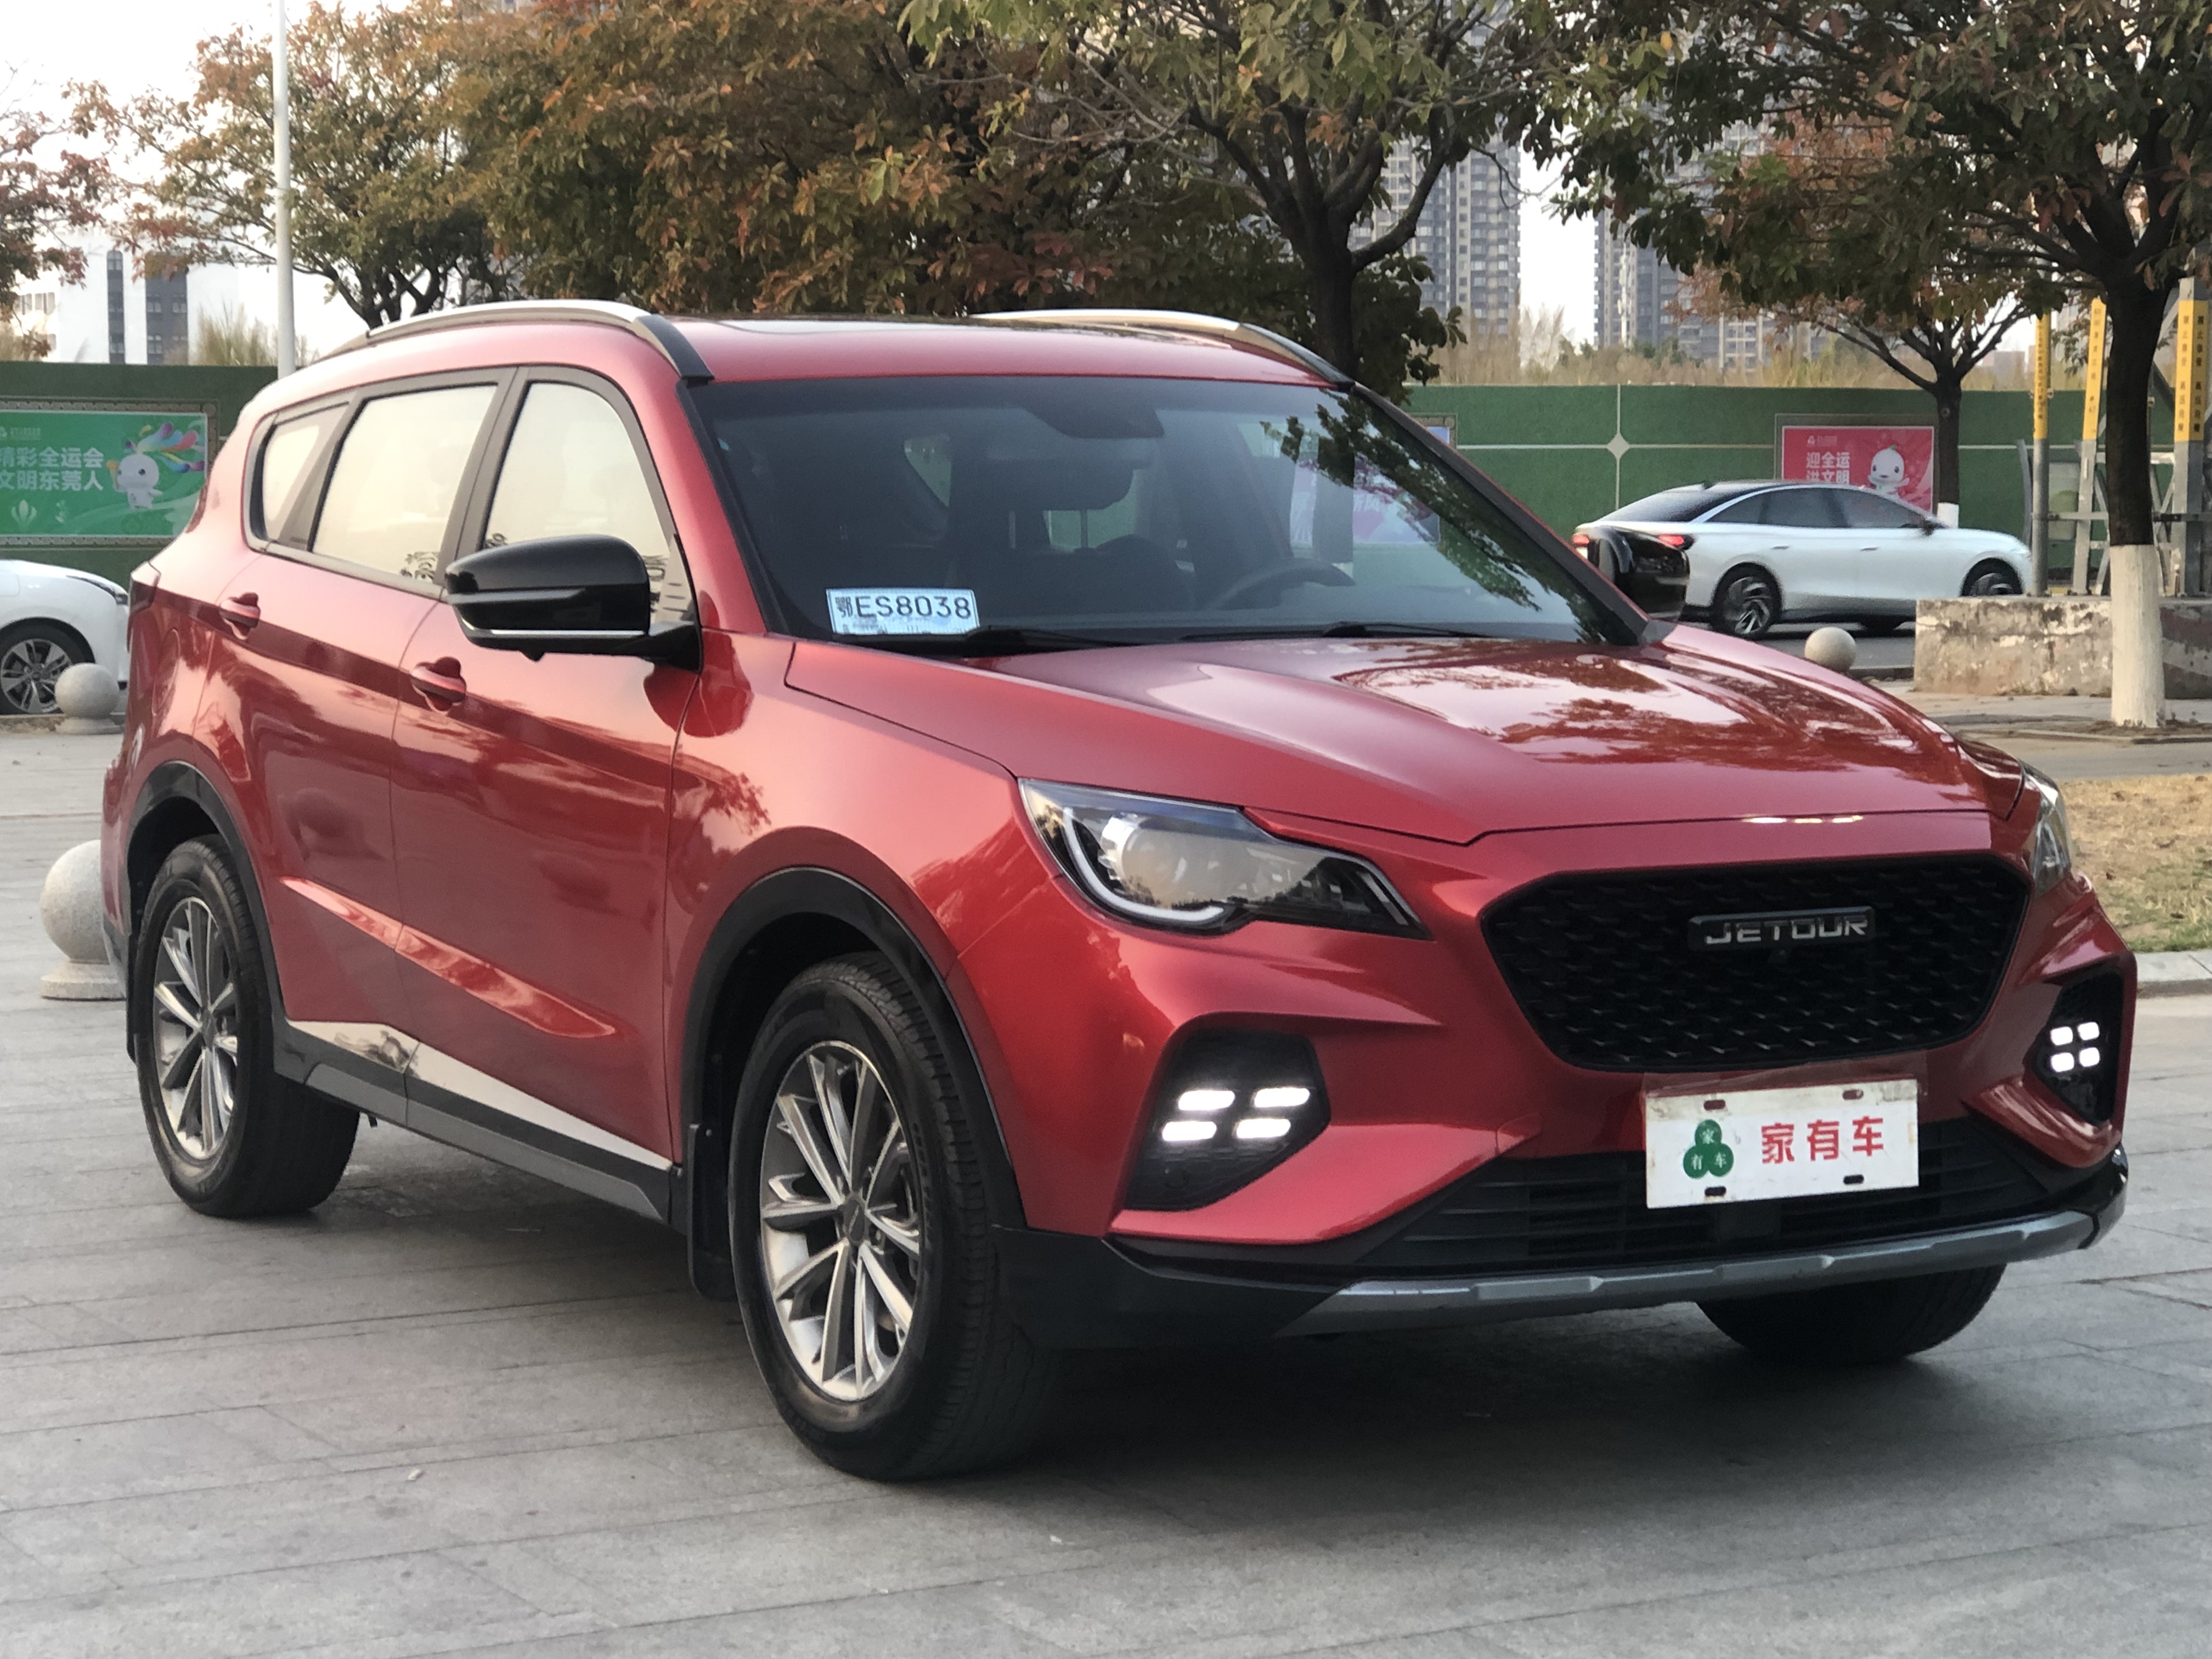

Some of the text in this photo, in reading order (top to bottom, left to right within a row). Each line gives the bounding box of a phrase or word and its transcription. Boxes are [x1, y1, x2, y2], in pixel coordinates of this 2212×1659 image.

[1806, 452, 1850, 469] 迎全运
[0, 470, 104, 491] 文明东莞人
[1705, 916, 1867, 945] JETOUR
[1761, 1115, 1883, 1165] 家有车
